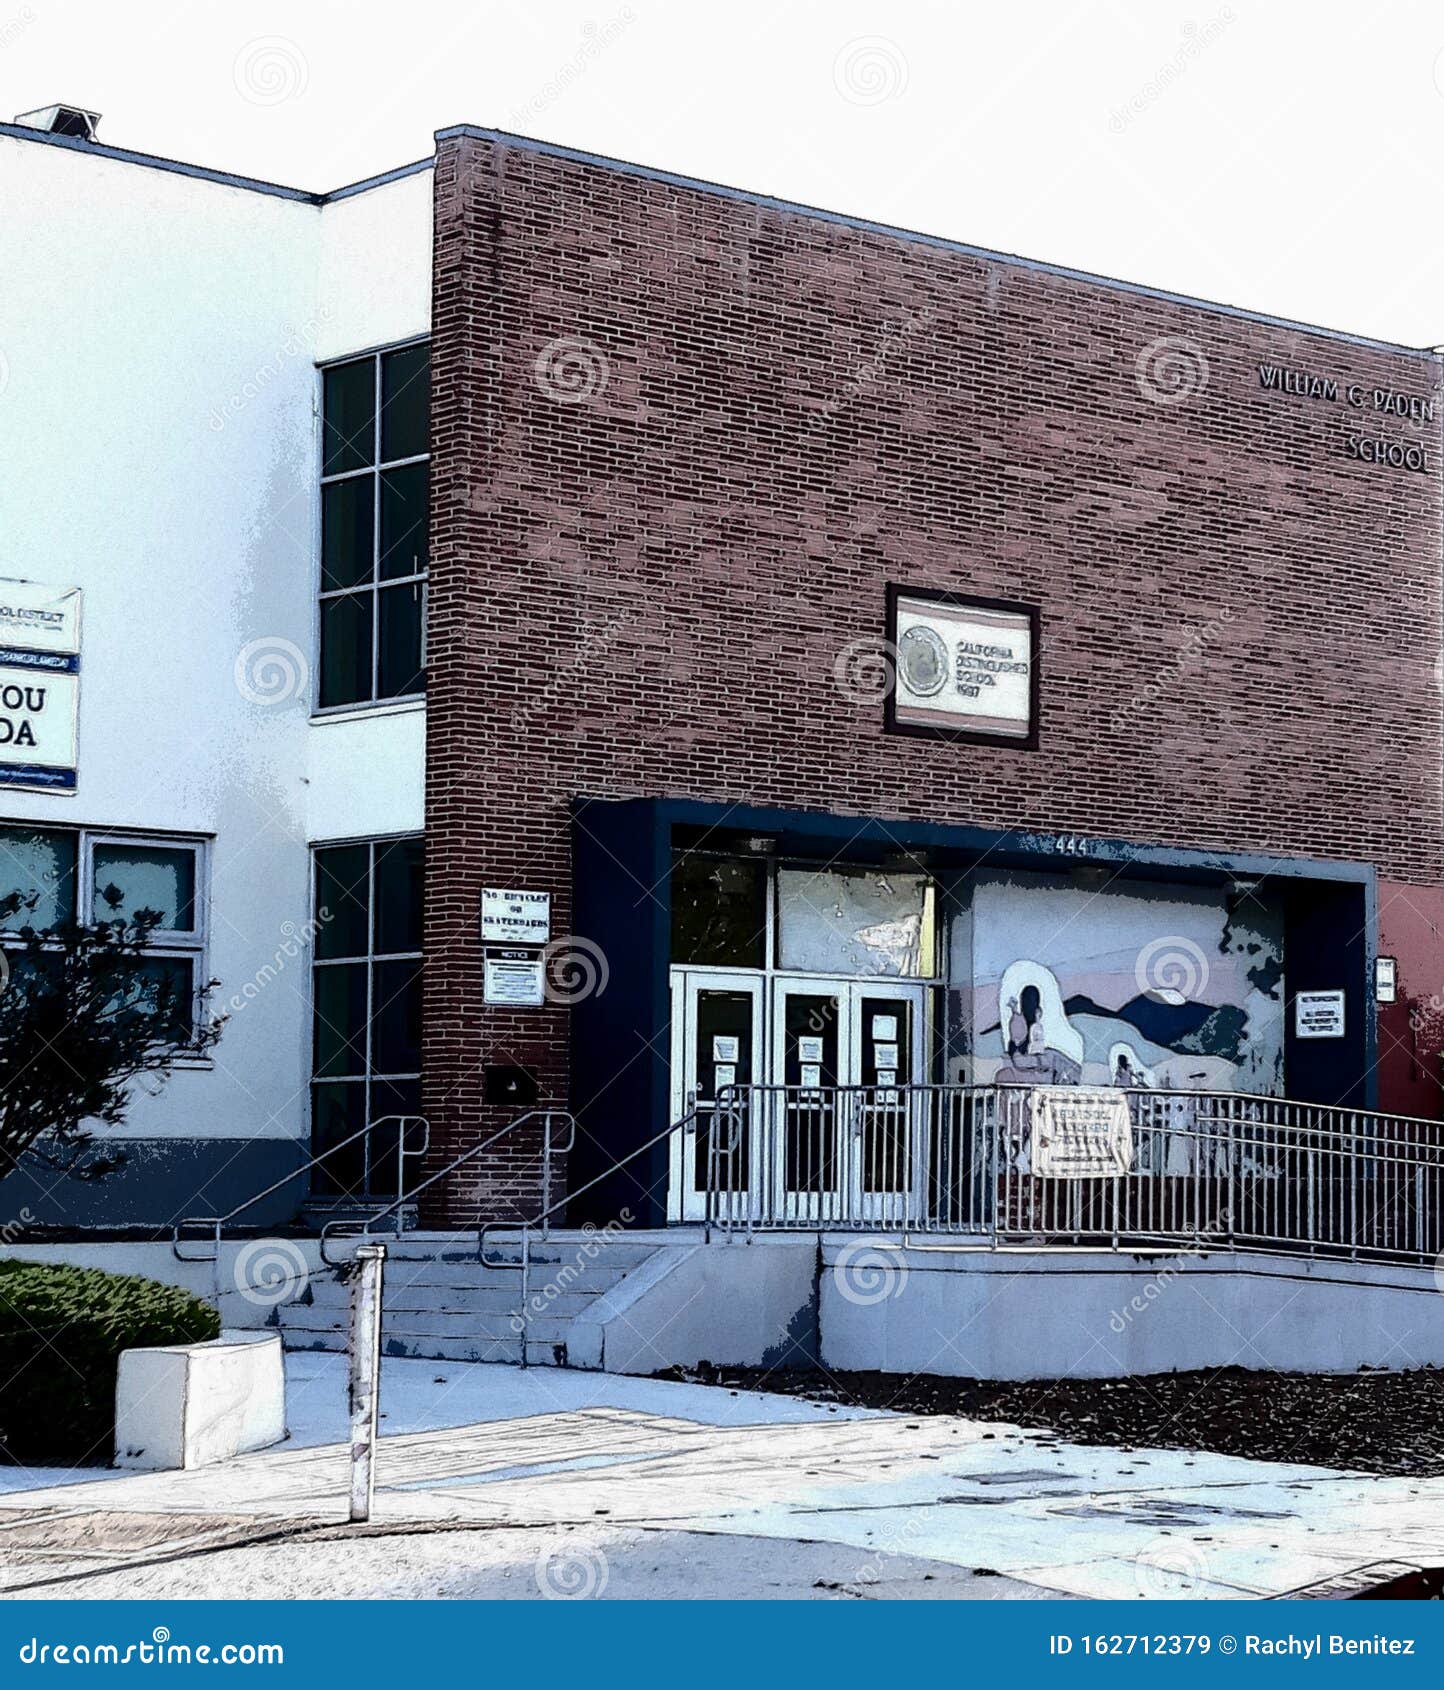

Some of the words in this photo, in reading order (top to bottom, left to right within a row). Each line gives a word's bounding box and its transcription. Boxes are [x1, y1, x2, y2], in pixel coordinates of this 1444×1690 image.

[1258, 364, 1338, 401] WILLIAM
[1349, 385, 1364, 407] G
[1373, 389, 1434, 421] PADEN
[1349, 435, 1432, 473] SCHOOL
[957, 641, 1014, 659] CALIFORNIA
[0, 684, 47, 713] OU
[1055, 834, 1088, 856] 444
[501, 951, 529, 959] NOTICE
